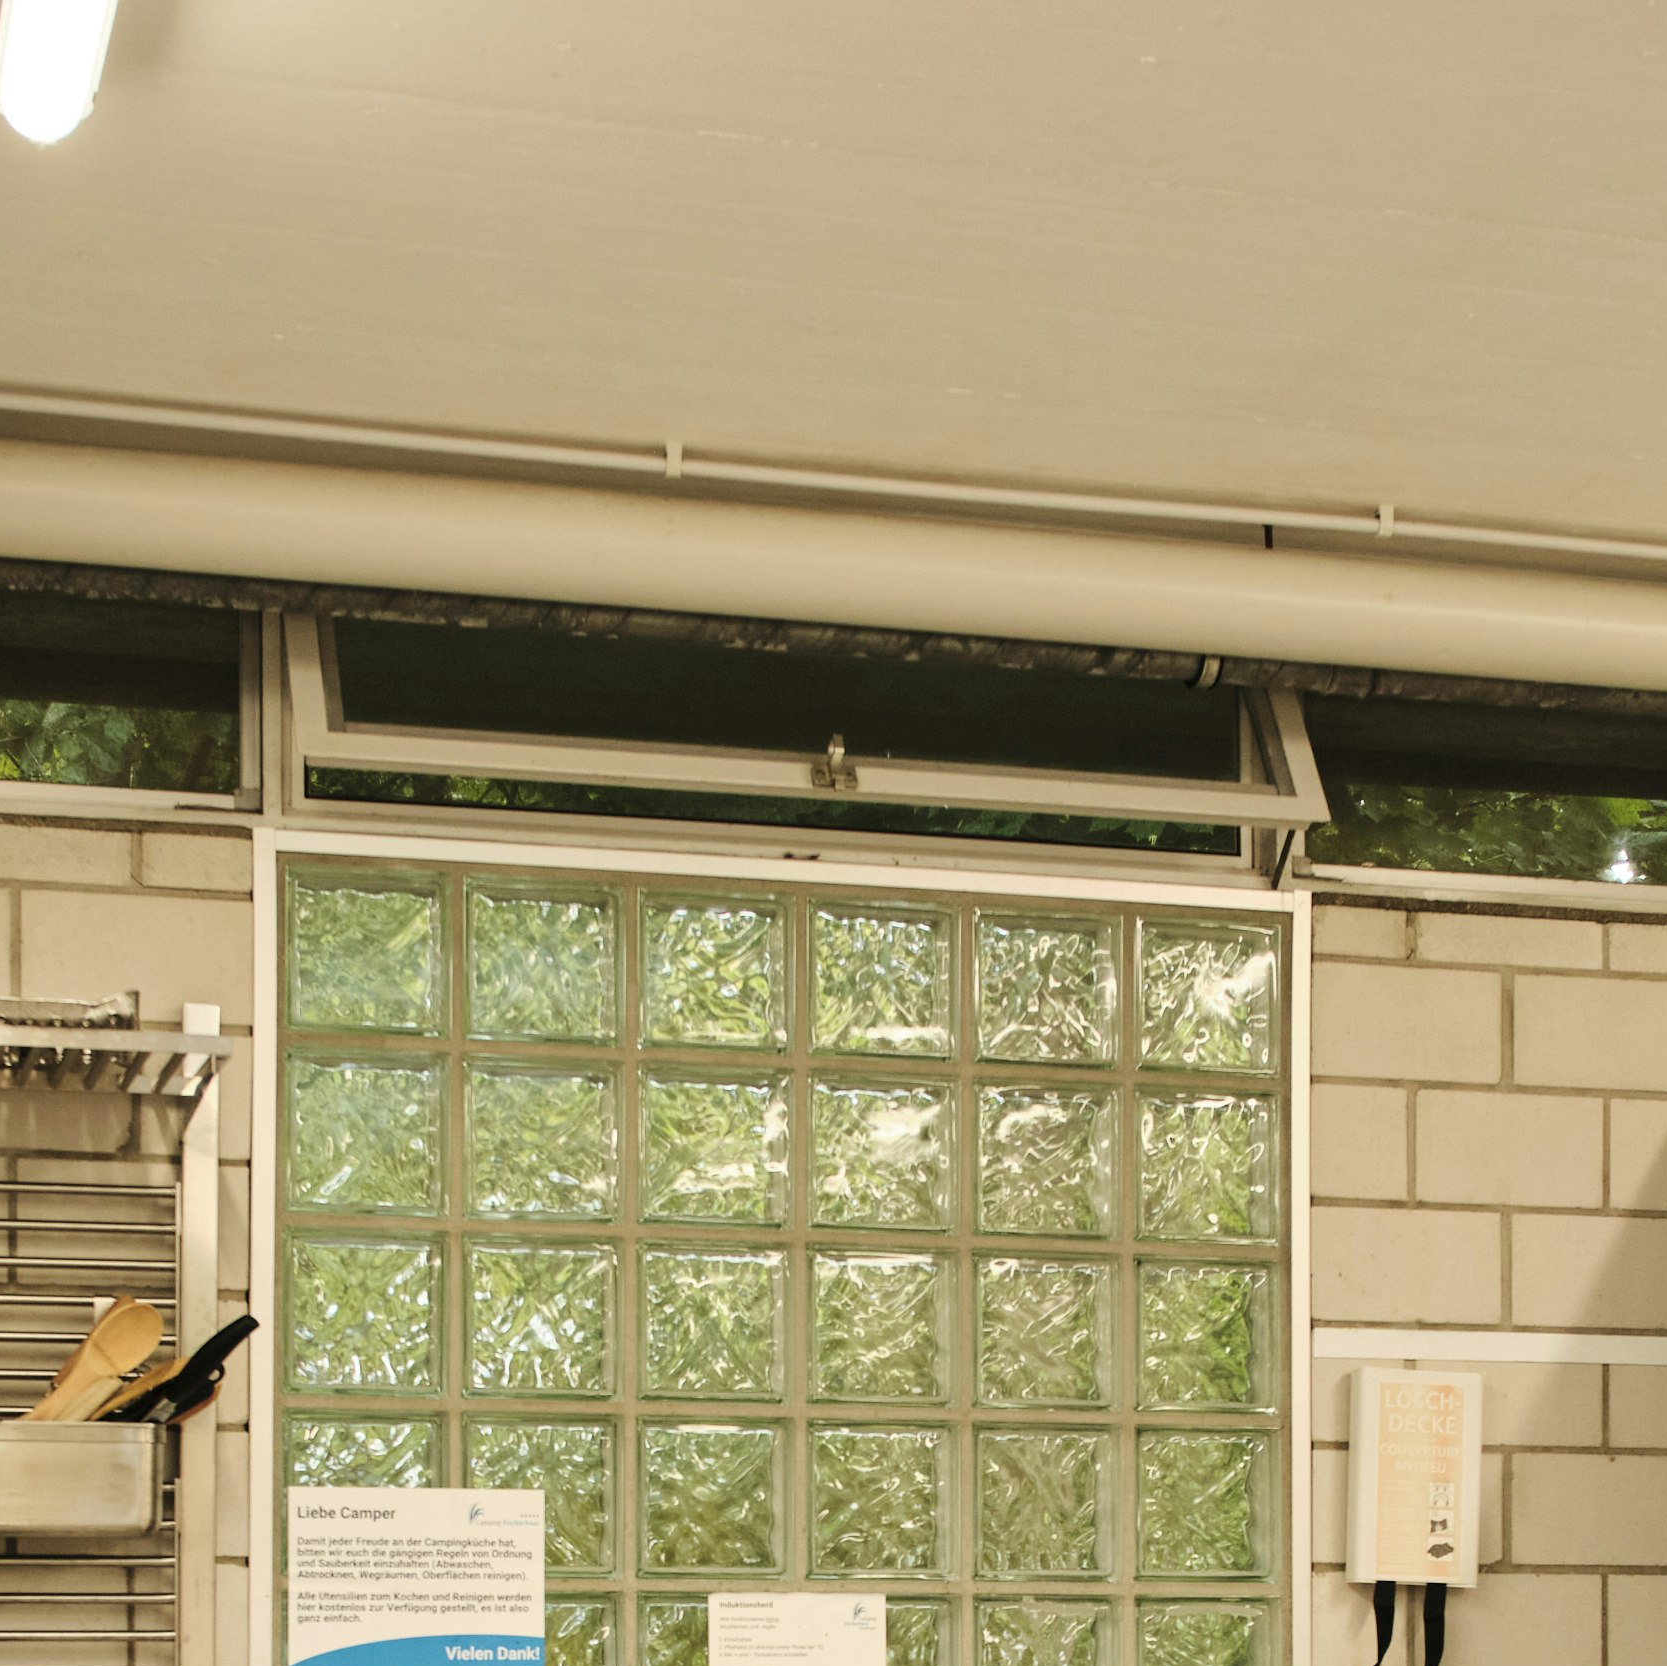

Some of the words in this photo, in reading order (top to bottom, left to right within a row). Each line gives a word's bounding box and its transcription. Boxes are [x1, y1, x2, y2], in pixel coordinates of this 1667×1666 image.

[1388, 1413, 1456, 1434] DECKE
[297, 1506, 336, 1519] Liebe
[340, 1506, 396, 1522] Camper
[297, 1537, 326, 1546] Damit
[328, 1537, 353, 1548] jeder
[356, 1537, 390, 1546] Freude
[406, 1537, 422, 1546] der
[424, 1537, 496, 1548] Campingküche
[498, 1538, 516, 1548] hat,
[297, 1547, 325, 1557] bitten
[329, 1549, 343, 1557] wir
[346, 1548, 369, 1557] euch
[372, 1548, 386, 1557] die
[436, 1549, 469, 1559] Regeln
[491, 1549, 533, 1560] Ordnung
[297, 1558, 316, 1567] und
[319, 1559, 371, 1568] Sauberkeit
[373, 1559, 430, 1568] einzuhalten
[297, 1570, 357, 1580] Abtrocknen,
[422, 1570, 481, 1580] Oberflächen
[298, 1592, 316, 1601] Alle
[319, 1592, 368, 1601] Utensilien
[370, 1593, 391, 1601] zum
[394, 1592, 430, 1601] Kochen
[432, 1593, 450, 1601] und
[453, 1593, 494, 1603] Reinigen
[497, 1593, 532, 1602] werden
[297, 1603, 315, 1611] hier
[318, 1603, 366, 1612] kostenlos
[386, 1604, 438, 1614] Verfügung
[440, 1604, 478, 1614] gestellt,
[495, 1604, 506, 1612] ist
[509, 1604, 529, 1612] also
[719, 1601, 774, 1609] Induktionsherd
[297, 1615, 320, 1625] ganz
[323, 1614, 363, 1623] einfach.
[445, 1646, 494, 1661] Vielen
[496, 1646, 541, 1661] Dank!
